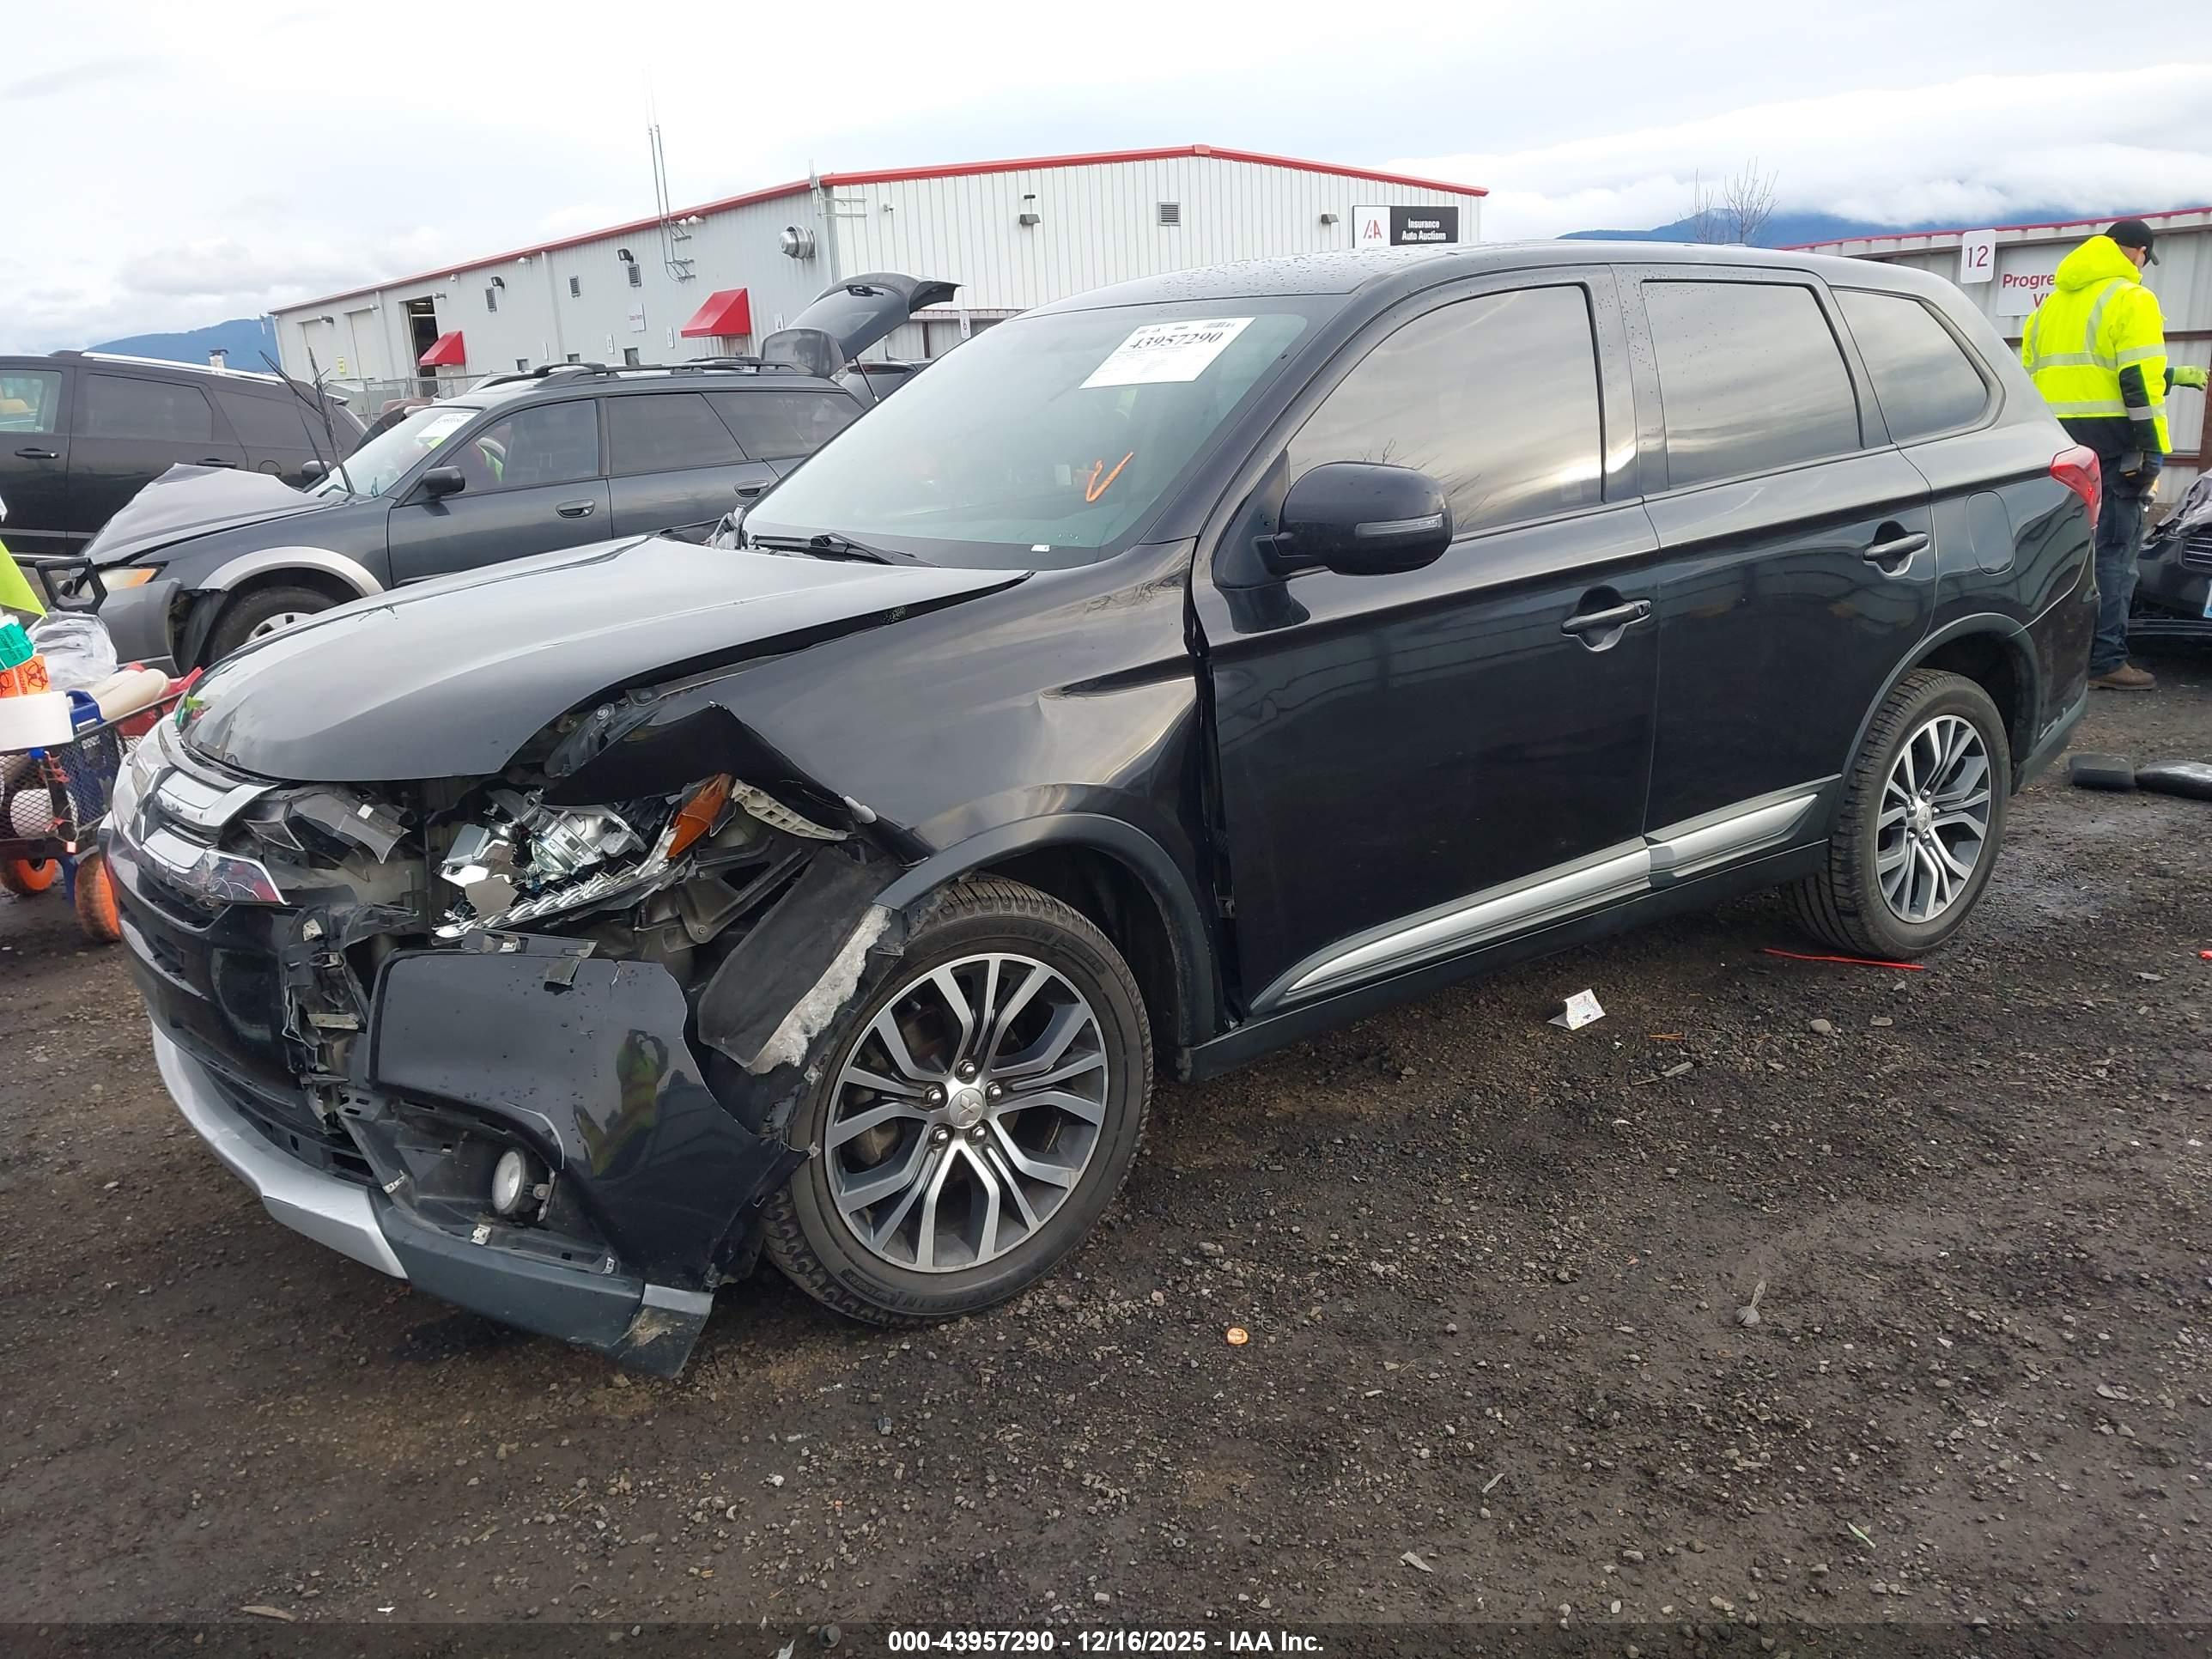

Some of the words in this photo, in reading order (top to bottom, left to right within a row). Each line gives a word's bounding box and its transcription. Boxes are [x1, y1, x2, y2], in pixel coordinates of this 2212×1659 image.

[1408, 217, 1440, 229] Insurance
[1401, 230, 1418, 241] Auto
[1419, 229, 1447, 241] Auctions
[1967, 245, 1989, 269] 12
[2002, 274, 2056, 290] Progre
[1129, 331, 1224, 349] 43957290
